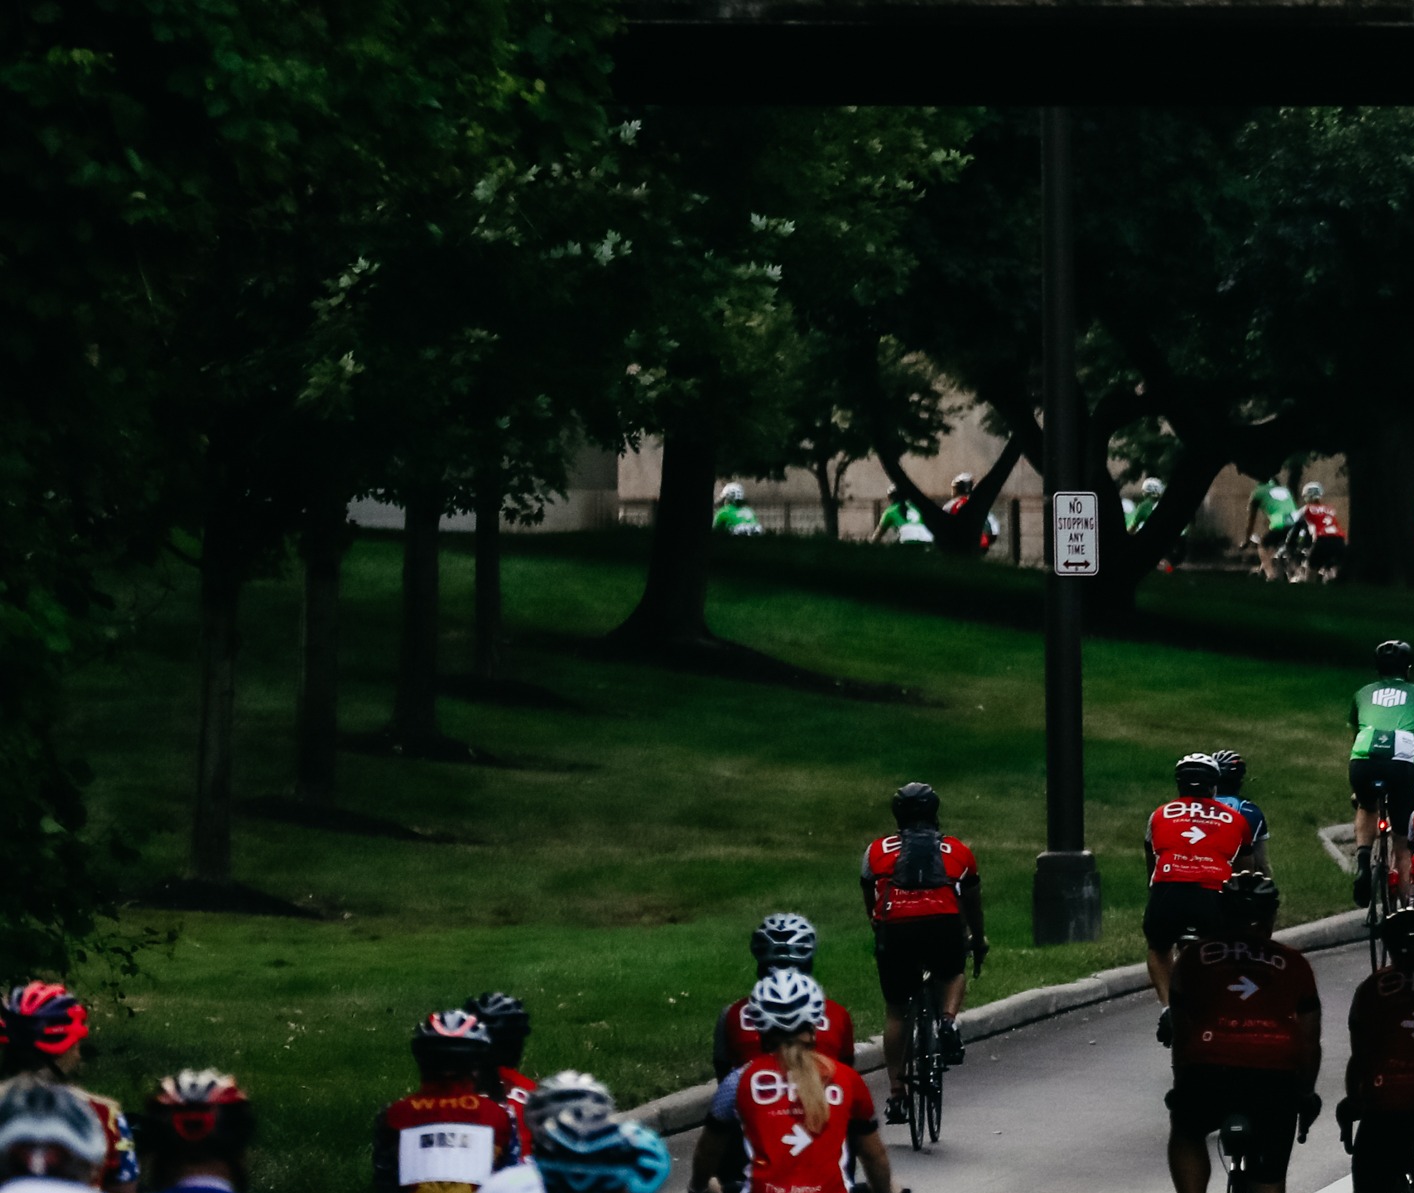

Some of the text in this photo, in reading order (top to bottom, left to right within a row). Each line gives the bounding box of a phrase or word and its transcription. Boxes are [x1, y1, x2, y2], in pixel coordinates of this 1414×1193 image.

[1068, 501, 1083, 514] NO
[1058, 517, 1095, 531] STOPPING
[1068, 532, 1084, 543] ANY
[1067, 545, 1086, 555] TIME
[1163, 801, 1233, 823] Ohio
[1199, 941, 1287, 971] Ohio
[410, 1095, 480, 1111] WHO
